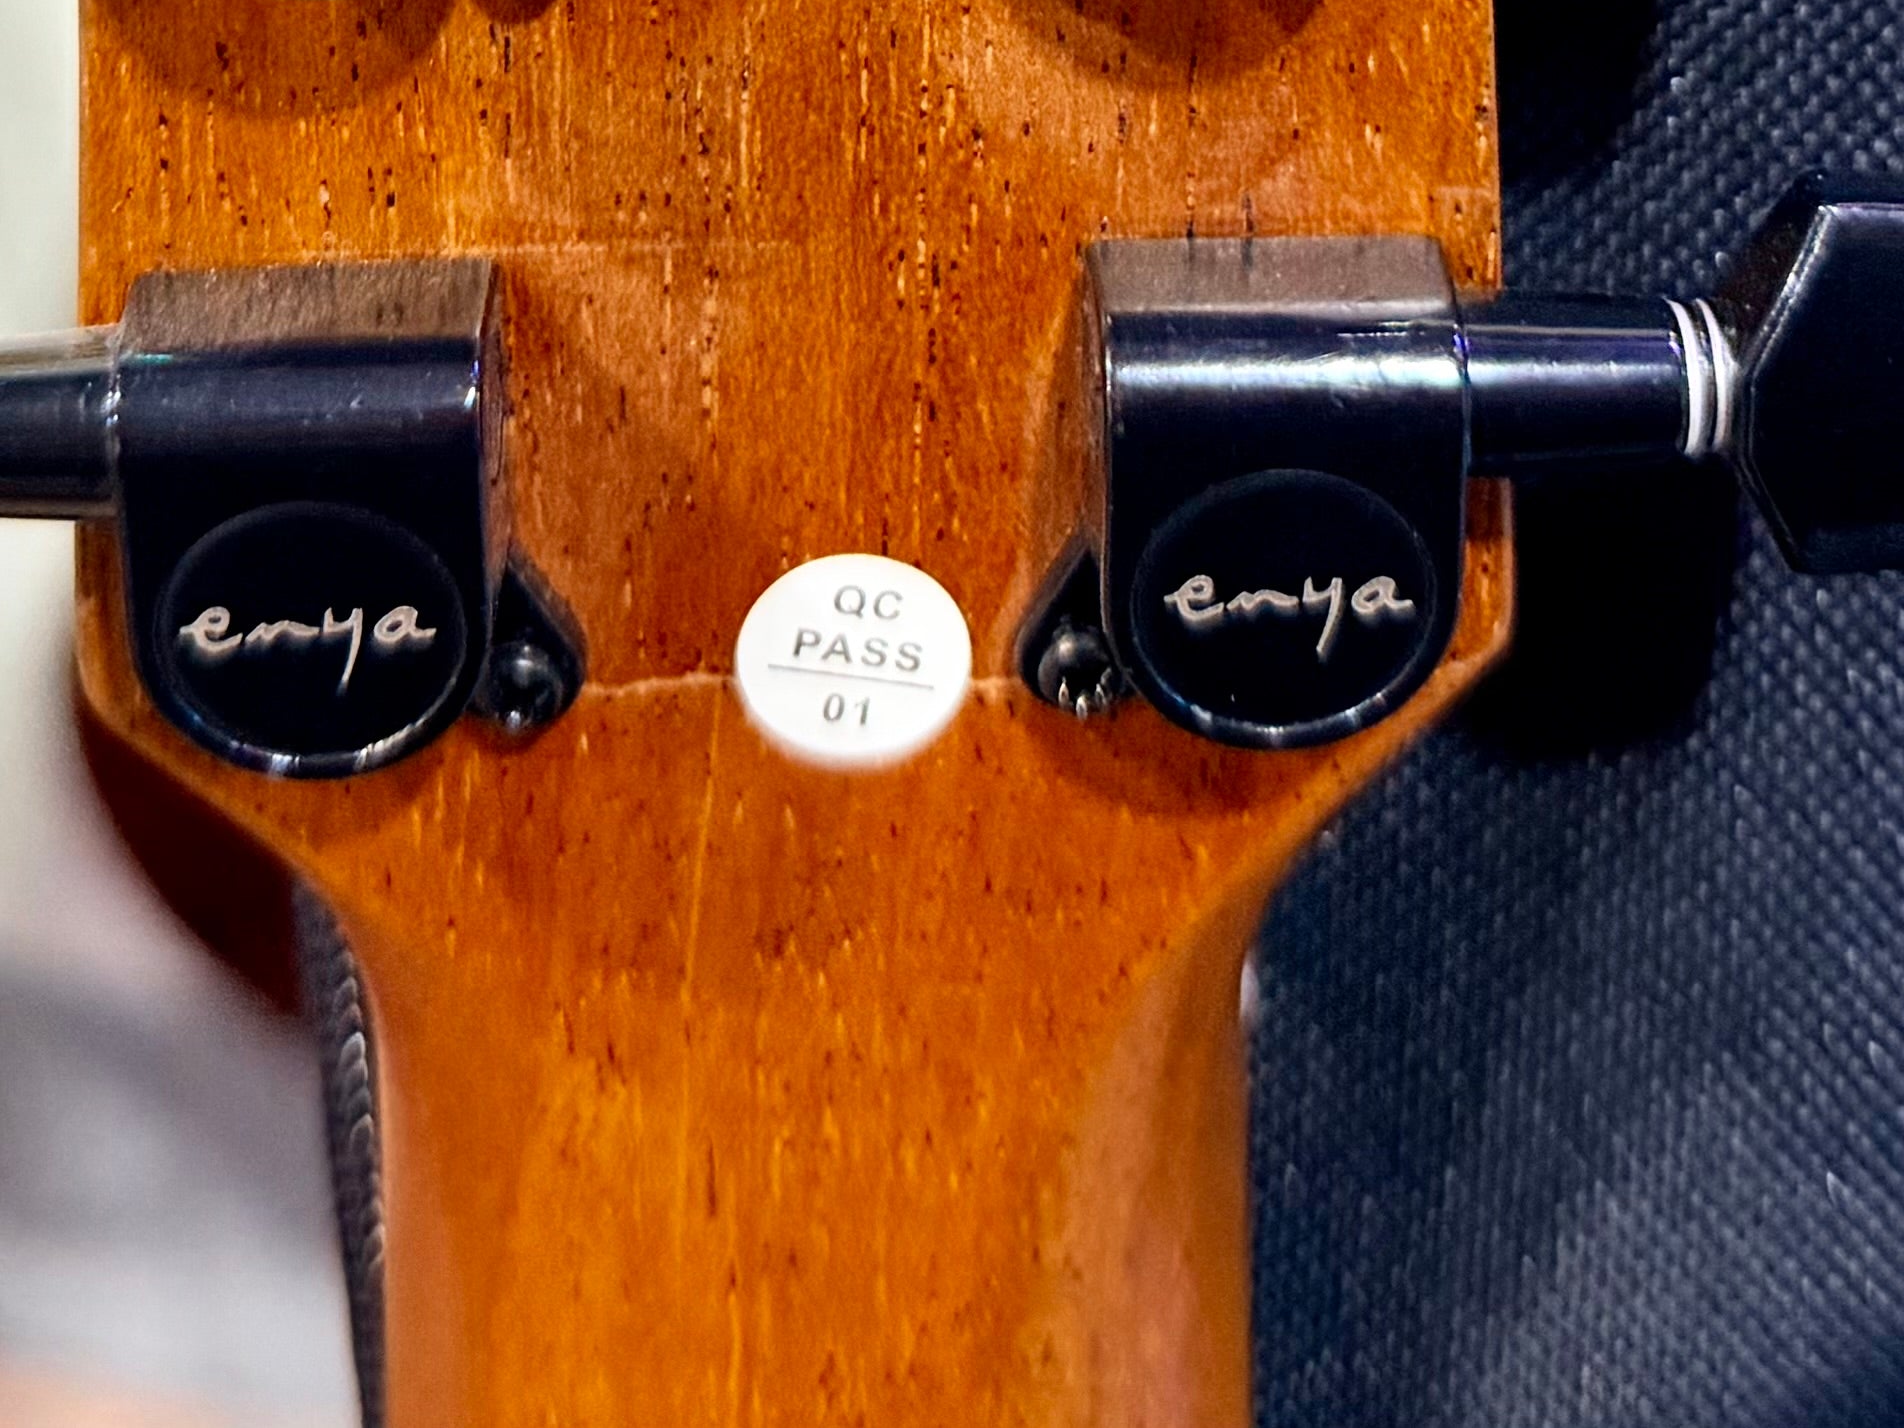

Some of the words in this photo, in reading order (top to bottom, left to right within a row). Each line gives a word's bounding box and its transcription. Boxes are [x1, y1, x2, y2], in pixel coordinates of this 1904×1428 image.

[833, 584, 904, 621] QC
[1163, 574, 1415, 662] enya
[179, 605, 438, 693] enya
[792, 627, 923, 673] PASS
[822, 693, 871, 727] 01
